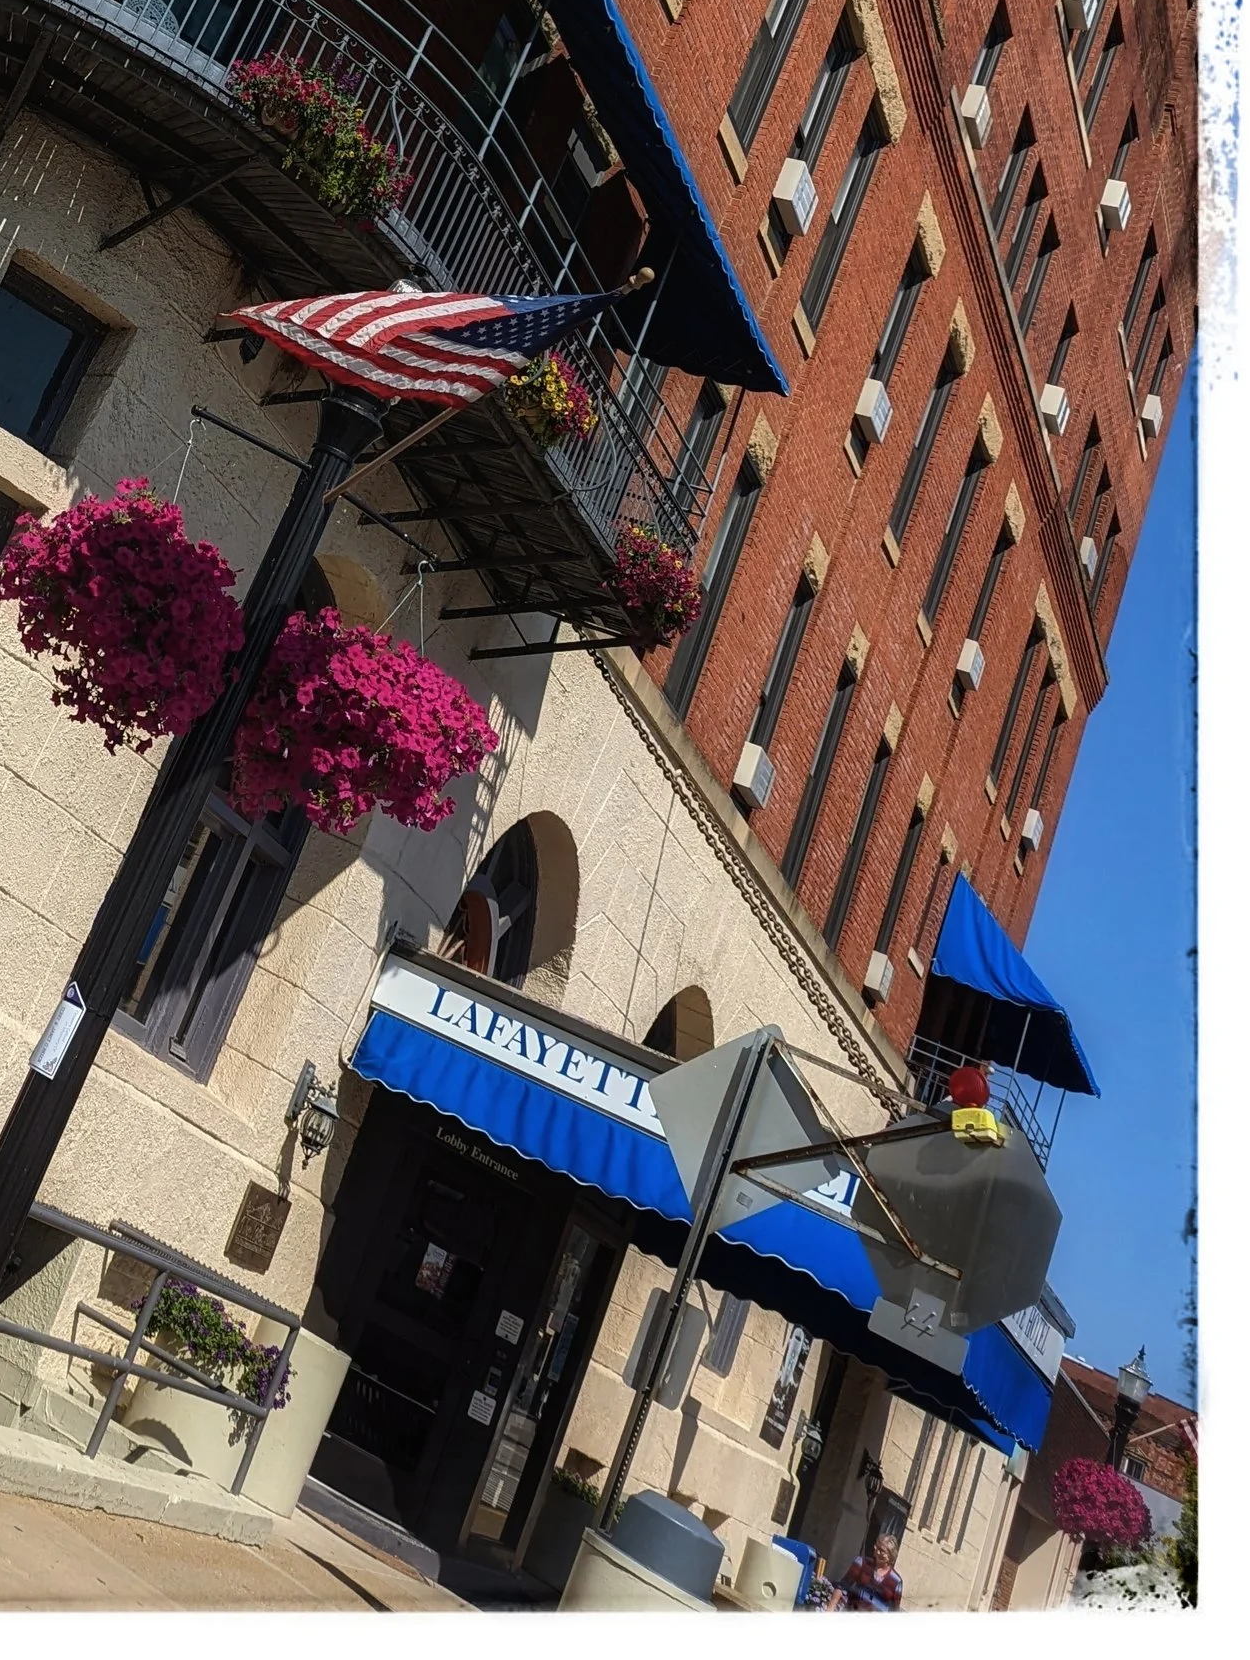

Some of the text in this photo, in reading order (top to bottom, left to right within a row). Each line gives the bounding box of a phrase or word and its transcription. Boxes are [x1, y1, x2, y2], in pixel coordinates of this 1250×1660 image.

[427, 986, 659, 1118] LAFAYETT
[436, 1126, 519, 1181] Lobby Entrance
[1024, 1306, 1051, 1356] HOTEL
